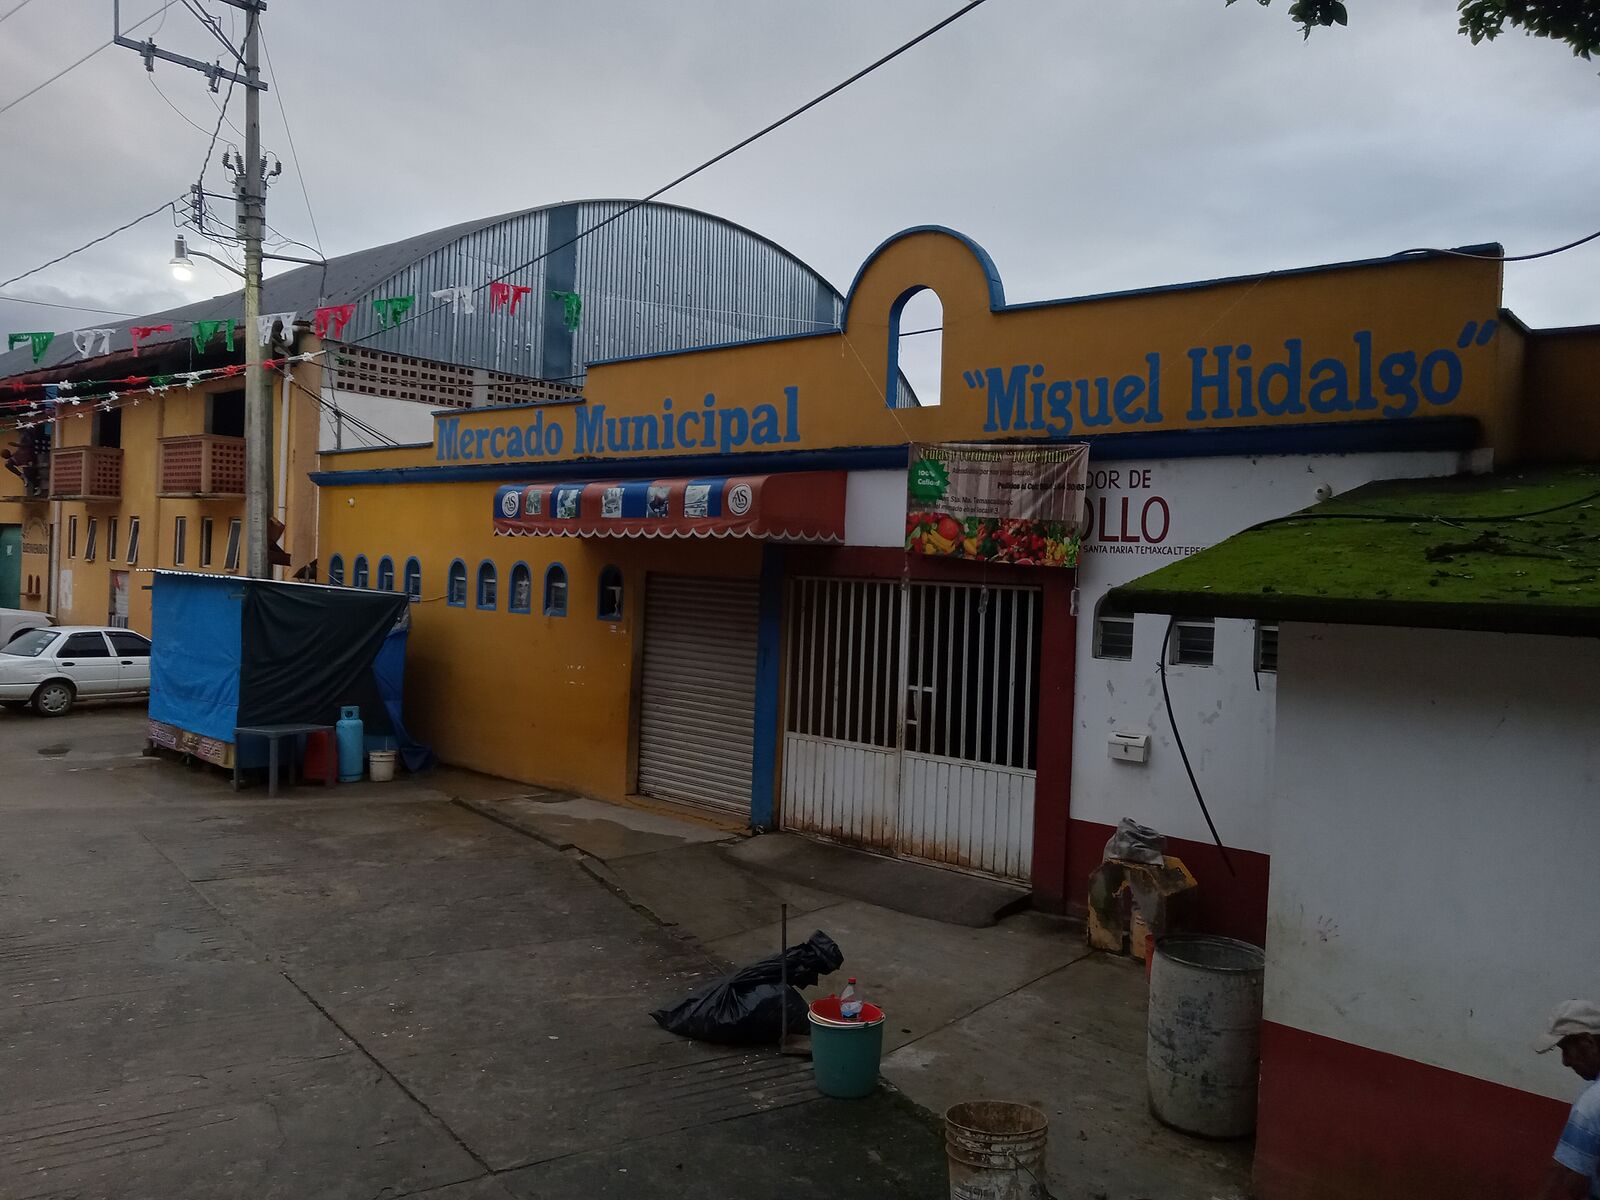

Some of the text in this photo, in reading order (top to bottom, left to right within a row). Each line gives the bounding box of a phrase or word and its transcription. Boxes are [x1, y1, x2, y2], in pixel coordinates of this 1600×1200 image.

[436, 385, 801, 461] Mercado Municipal
[1129, 469, 1152, 489] DE
[1083, 545, 1108, 554] SANTA
[1110, 545, 1134, 555] MARIA
